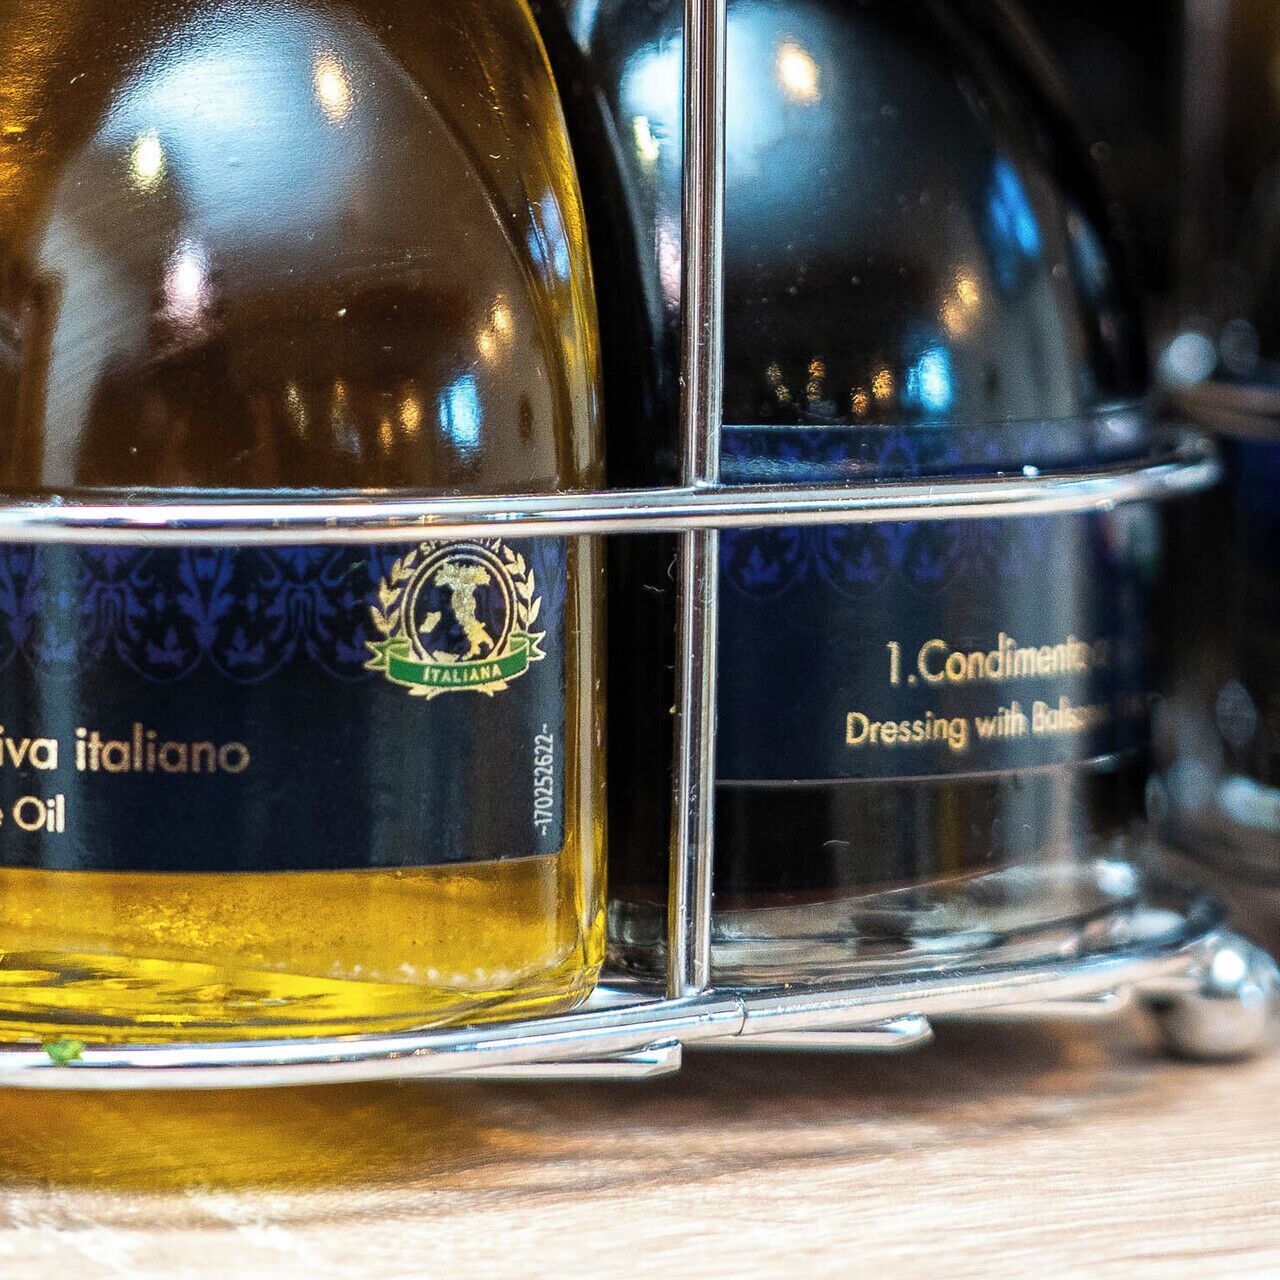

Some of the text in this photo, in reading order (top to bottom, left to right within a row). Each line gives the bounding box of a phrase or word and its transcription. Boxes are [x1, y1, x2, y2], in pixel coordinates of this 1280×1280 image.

[424, 663, 502, 683] ITALIANA
[76, 722, 251, 774] italiano
[845, 711, 969, 751] Dressing
[975, 700, 1027, 738] with
[12, 793, 66, 833] Oil
